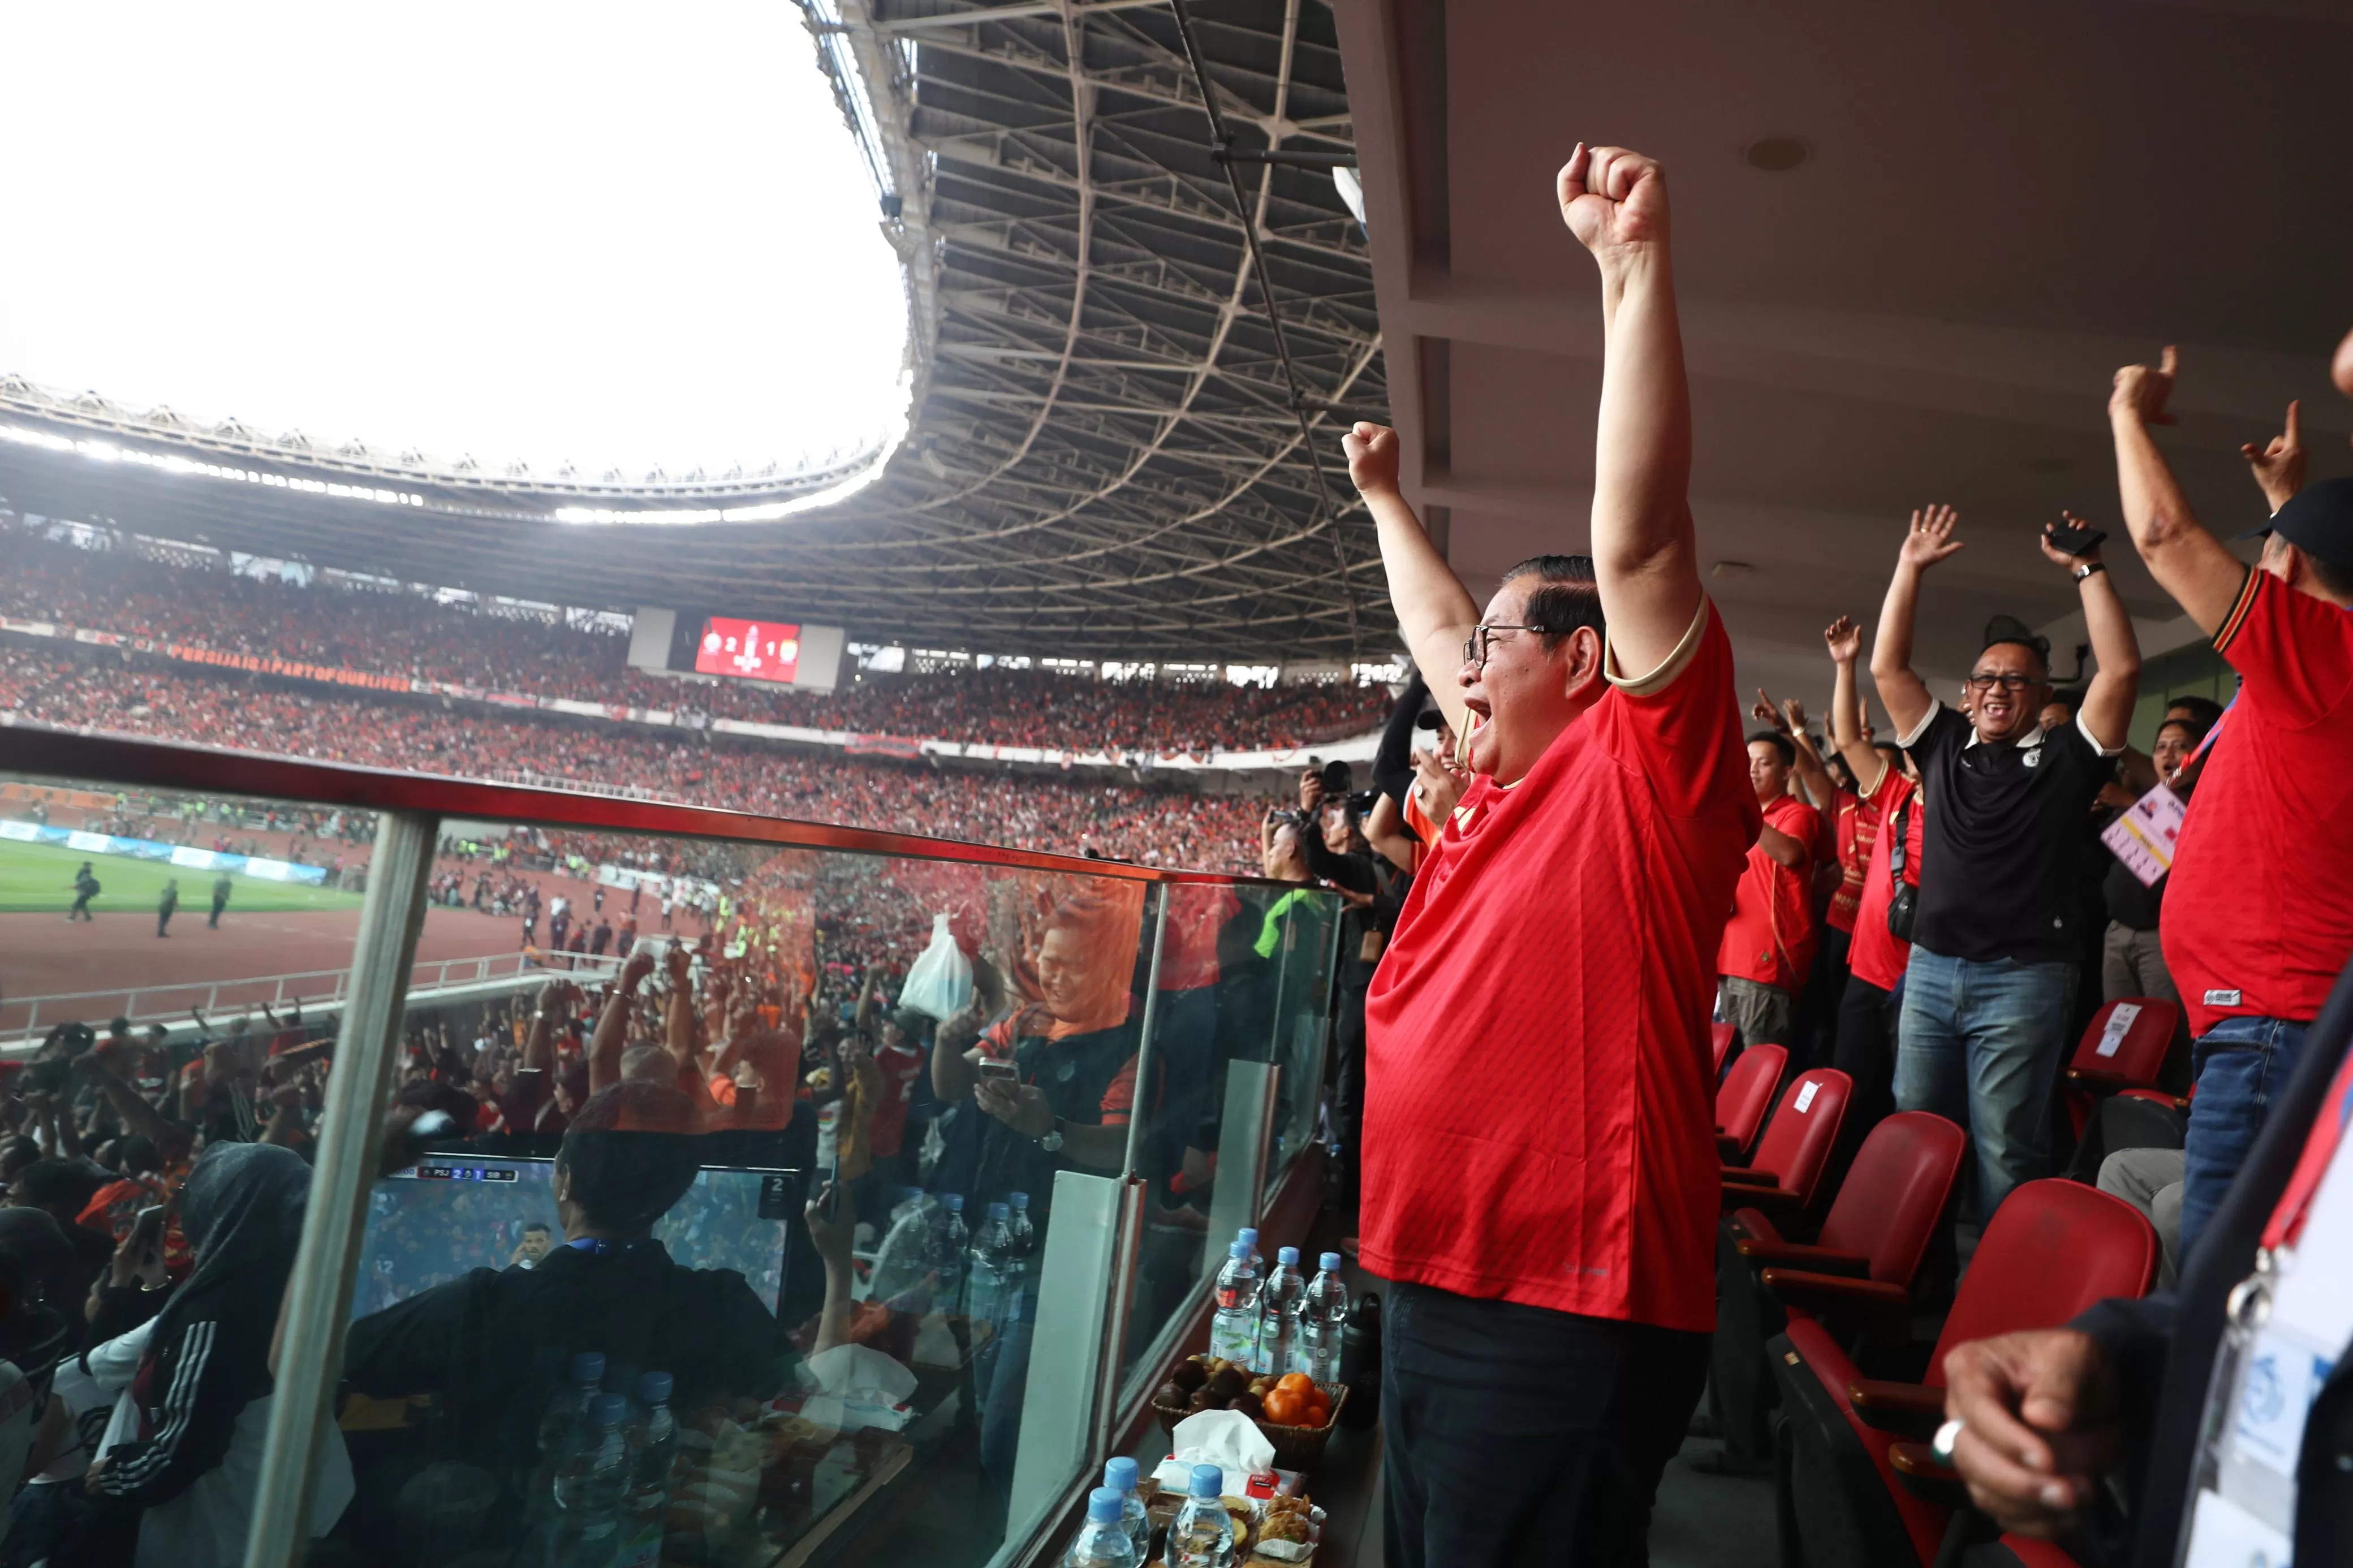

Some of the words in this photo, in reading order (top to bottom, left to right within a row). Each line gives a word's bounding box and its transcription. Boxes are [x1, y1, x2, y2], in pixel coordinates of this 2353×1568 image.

[725, 636, 738, 652] 2
[766, 641, 775, 656] 1
[171, 644, 240, 668] PERSIJA
[241, 654, 260, 671] IS
[261, 658, 270, 673] A
[271, 659, 314, 679] PART
[314, 666, 336, 683] OF
[336, 669, 368, 688] OUR
[433, 1168, 450, 1177] PSJ
[453, 1169, 463, 1179] 2
[475, 1170, 481, 1180] 1
[772, 1177, 783, 1192] 2
